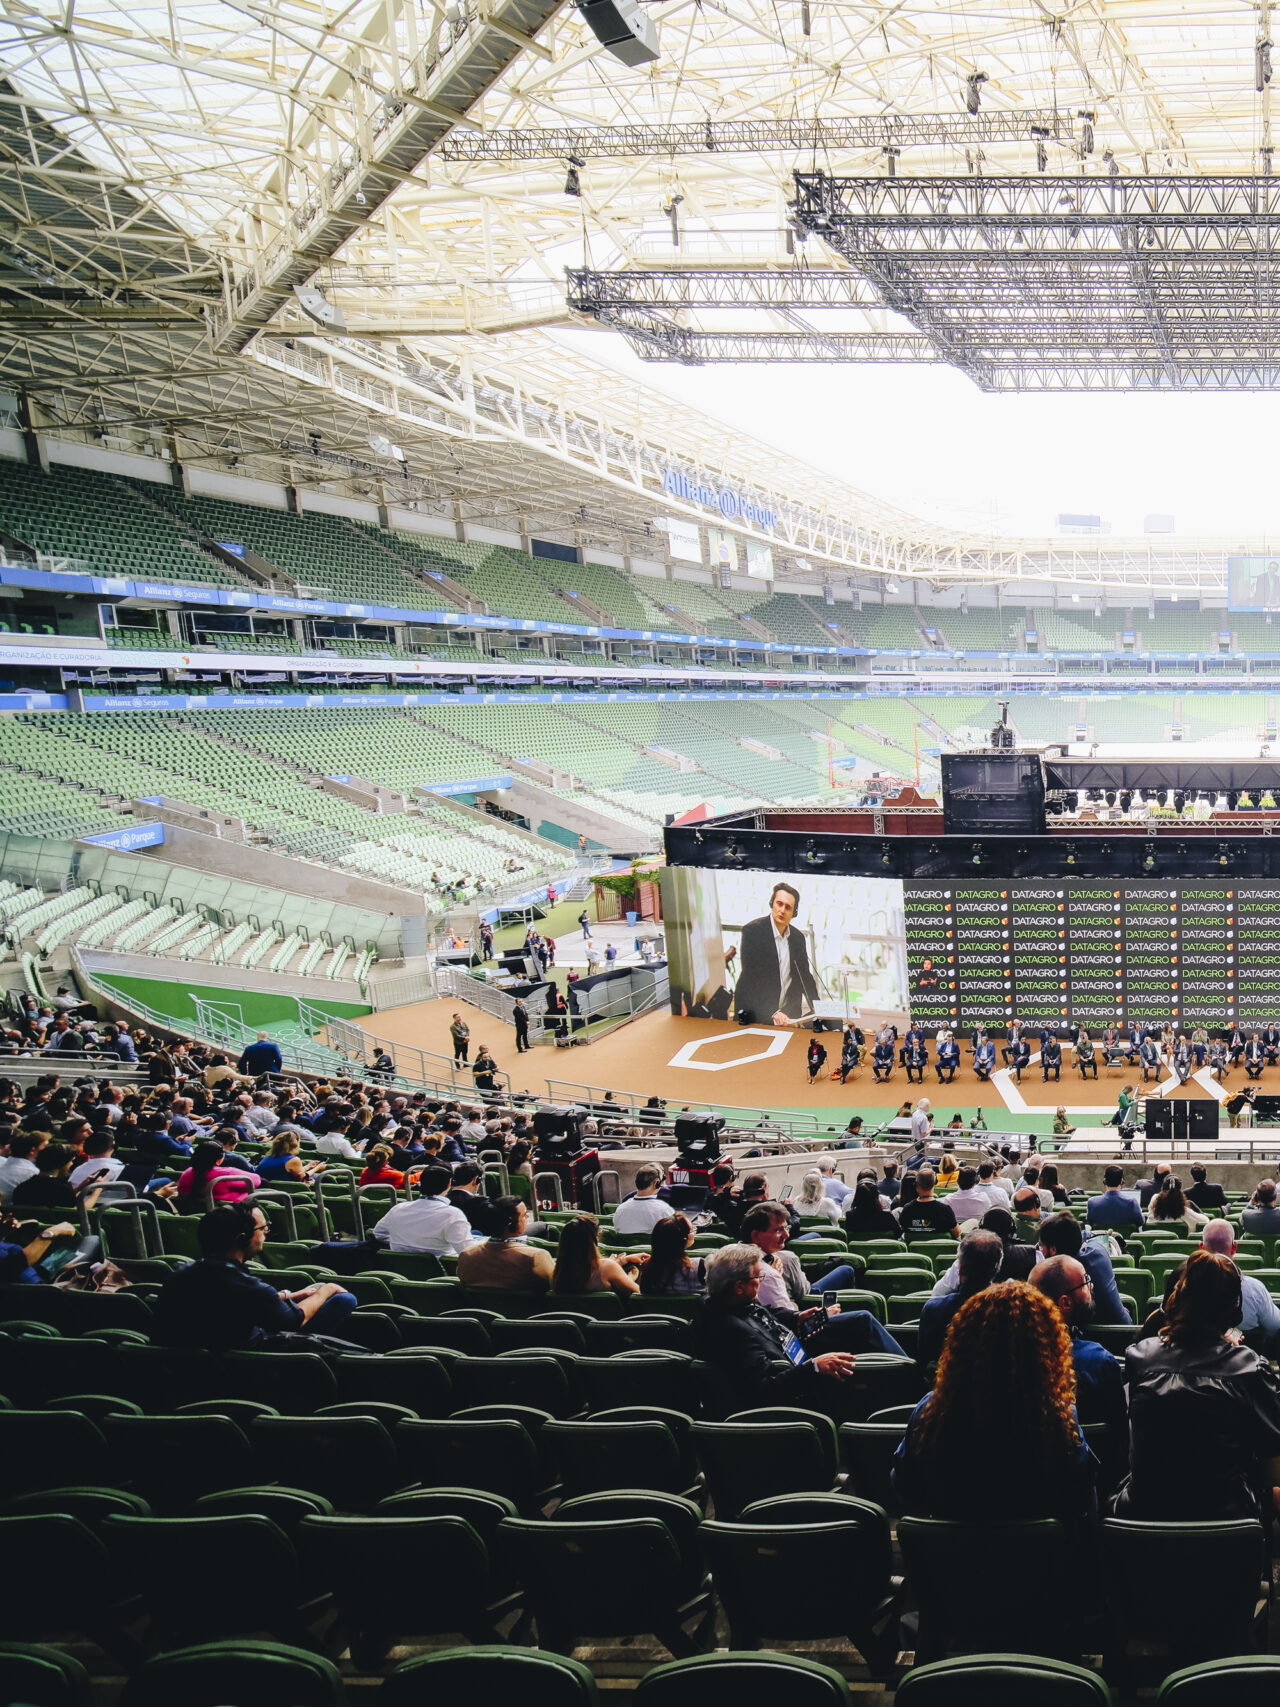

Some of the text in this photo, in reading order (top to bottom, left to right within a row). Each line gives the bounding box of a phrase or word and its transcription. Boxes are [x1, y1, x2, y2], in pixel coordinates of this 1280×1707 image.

[663, 467, 779, 530] Allianz Parque
[144, 585, 211, 599] Allianz Seguros
[272, 599, 326, 610] Allianz Parque
[143, 699, 169, 707] Seguros
[131, 831, 155, 843] Parque
[1013, 917, 1056, 925] DATAGRO
[1126, 917, 1169, 925] DATAGRO
[1238, 917, 1280, 925] DATAGRO
[957, 930, 1000, 938] DATAGRO
[1070, 930, 1113, 938] DATAGRO
[1182, 930, 1225, 938] DATAGRO
[1126, 943, 1169, 951] DATAGRO
[1182, 943, 1225, 951] DATAGRO
[1238, 943, 1280, 951] DATAGRO
[1183, 956, 1225, 964] DATAGRO
[1015, 969, 1058, 977] DATAGRO
[1127, 969, 1169, 977] DATAGRO
[1183, 982, 1225, 990] DATAGRO
[1239, 982, 1280, 990] DATAGRO
[1072, 995, 1114, 1003] DATAGRO
[1127, 995, 1170, 1003] DATAGRO
